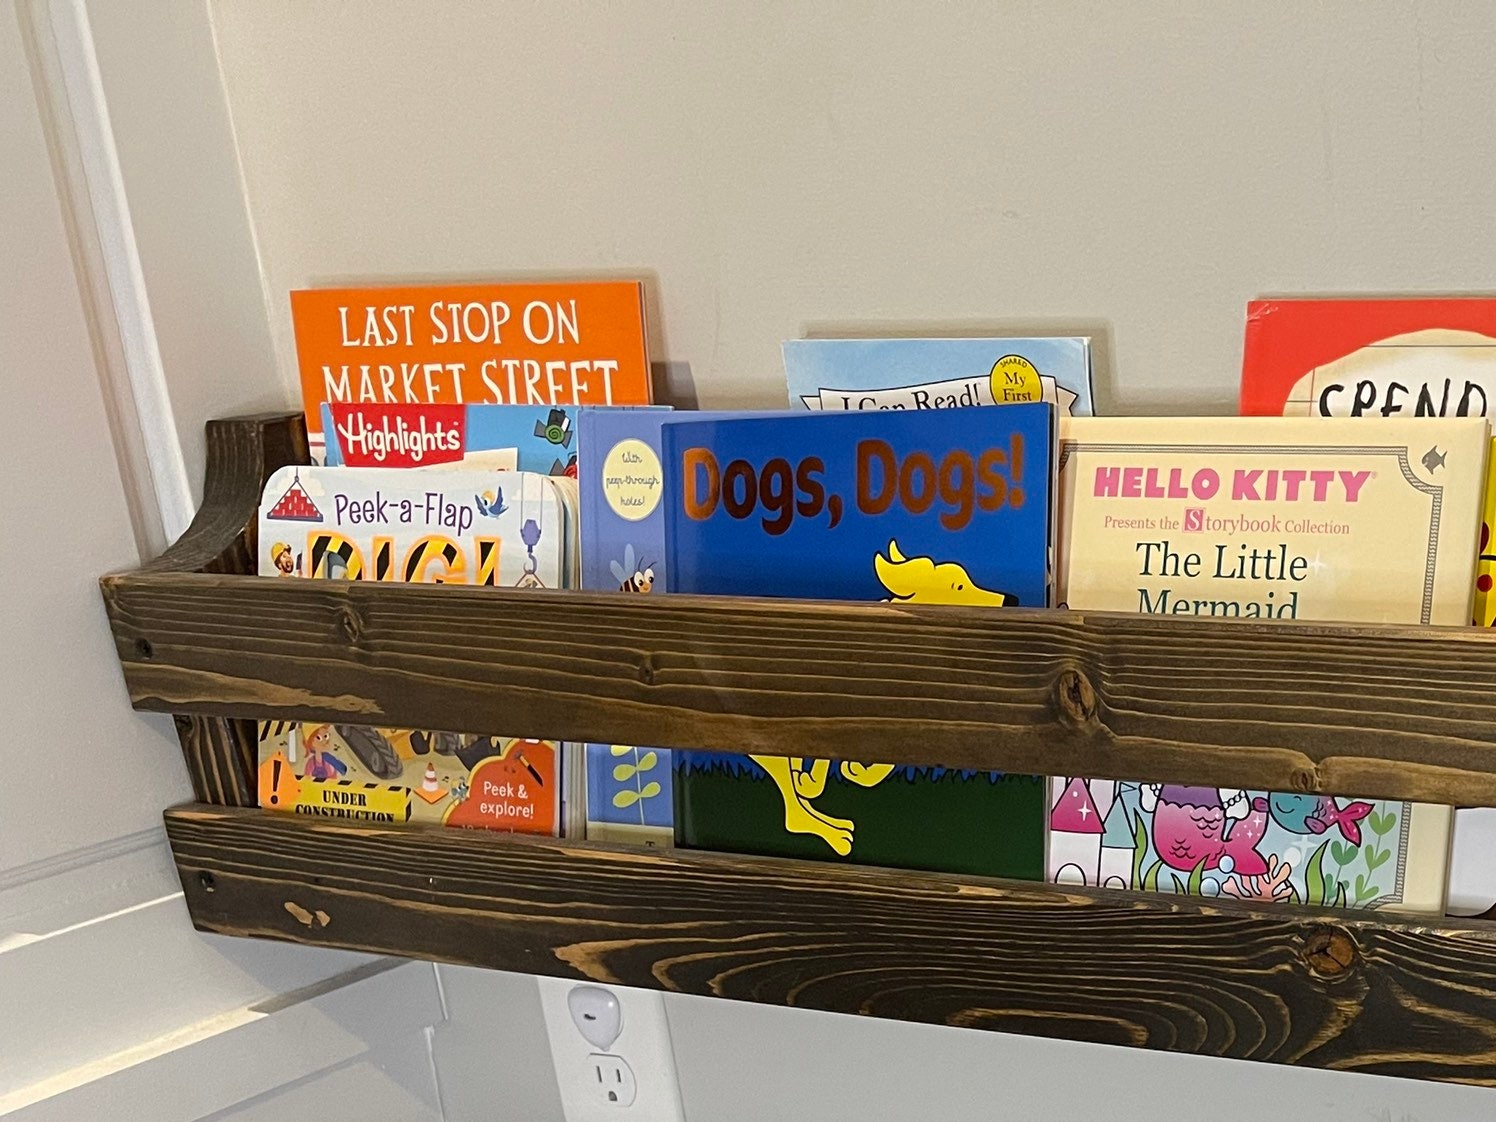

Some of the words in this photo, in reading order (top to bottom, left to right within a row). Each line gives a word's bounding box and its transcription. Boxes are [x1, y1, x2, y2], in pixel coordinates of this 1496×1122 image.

[339, 305, 414, 347] LAST
[431, 301, 510, 345] STOP
[523, 300, 580, 344] ON
[1000, 358, 1027, 369] SHARED
[323, 362, 465, 404] MARKET
[481, 360, 619, 405] STREET
[1004, 372, 1026, 388] My
[1003, 389, 1032, 402] First
[338, 412, 460, 461] Highlights
[683, 446, 843, 535] Dogs,
[856, 433, 1025, 531] Dogs!
[1094, 467, 1220, 500] HELLO
[1232, 470, 1371, 502] KITTY
[335, 491, 473, 536] Peek-a-Flap
[1104, 515, 1156, 529] Presents
[1160, 516, 1179, 529] the
[1183, 507, 1282, 535] Storybook
[1285, 519, 1350, 534] Collection
[1136, 541, 1201, 577] The
[1213, 543, 1308, 581] Little
[1138, 588, 1298, 619] Mermaid
[323, 790, 366, 806] UNDER
[484, 781, 514, 797] Peek
[518, 784, 528, 799] &
[296, 804, 394, 822] CONSTRUCTION
[480, 802, 533, 819] explore!
